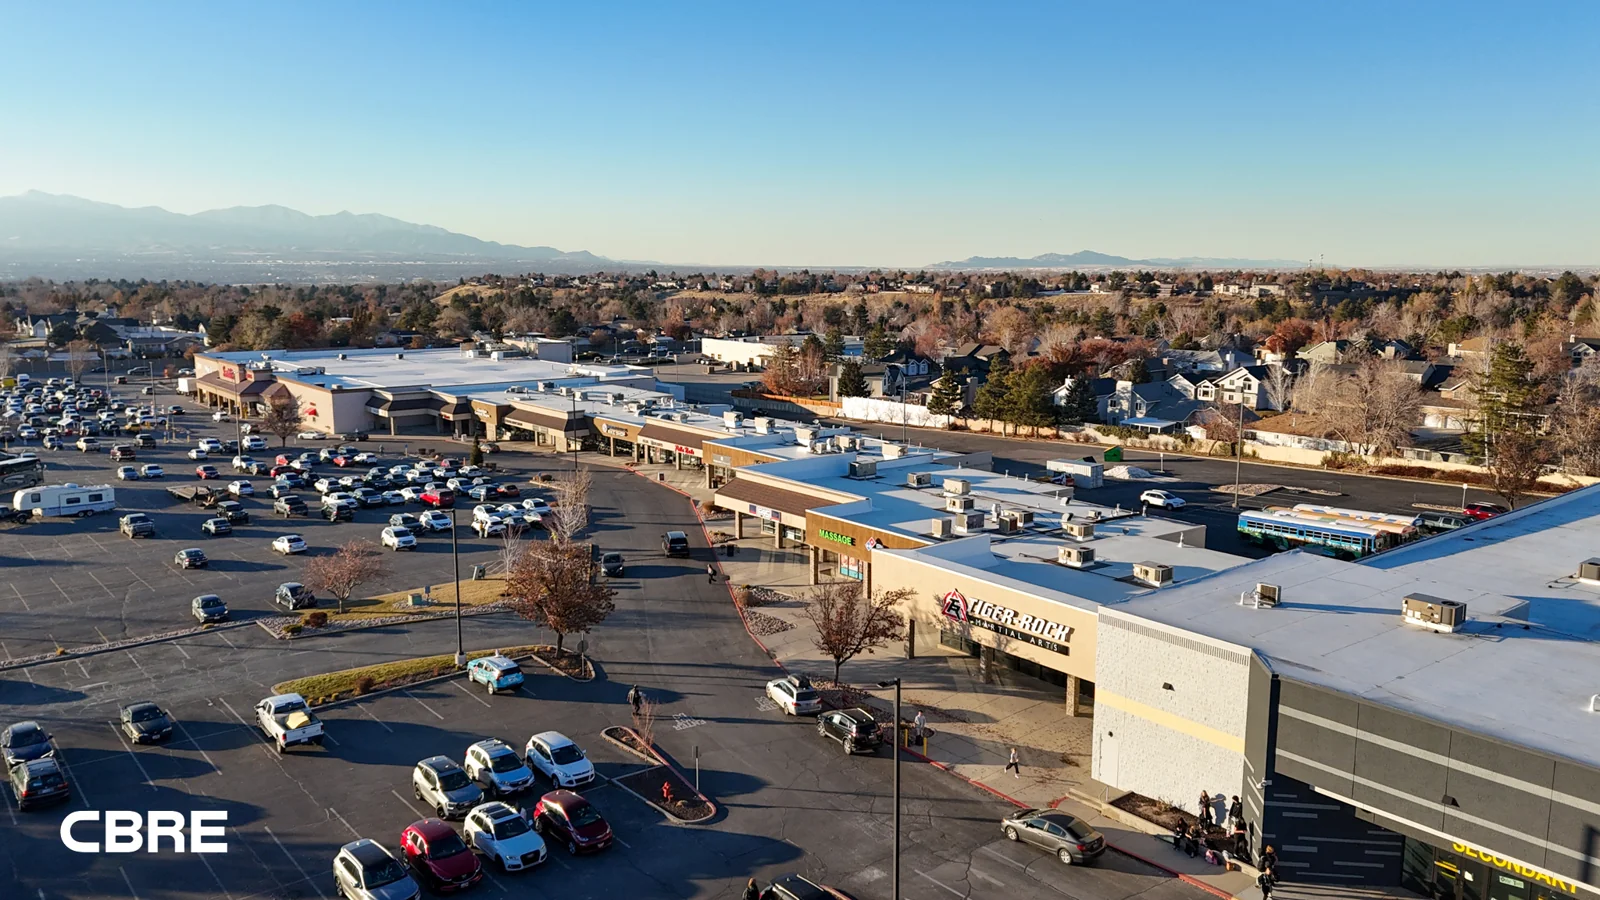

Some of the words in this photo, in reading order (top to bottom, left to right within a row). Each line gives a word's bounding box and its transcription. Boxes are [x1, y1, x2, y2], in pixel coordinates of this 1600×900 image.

[819, 529, 852, 546] MASSAGE
[967, 597, 1071, 642] TIGER-ROCK
[975, 619, 1022, 640] MARTIAL
[1029, 636, 1058, 652] ARTS
